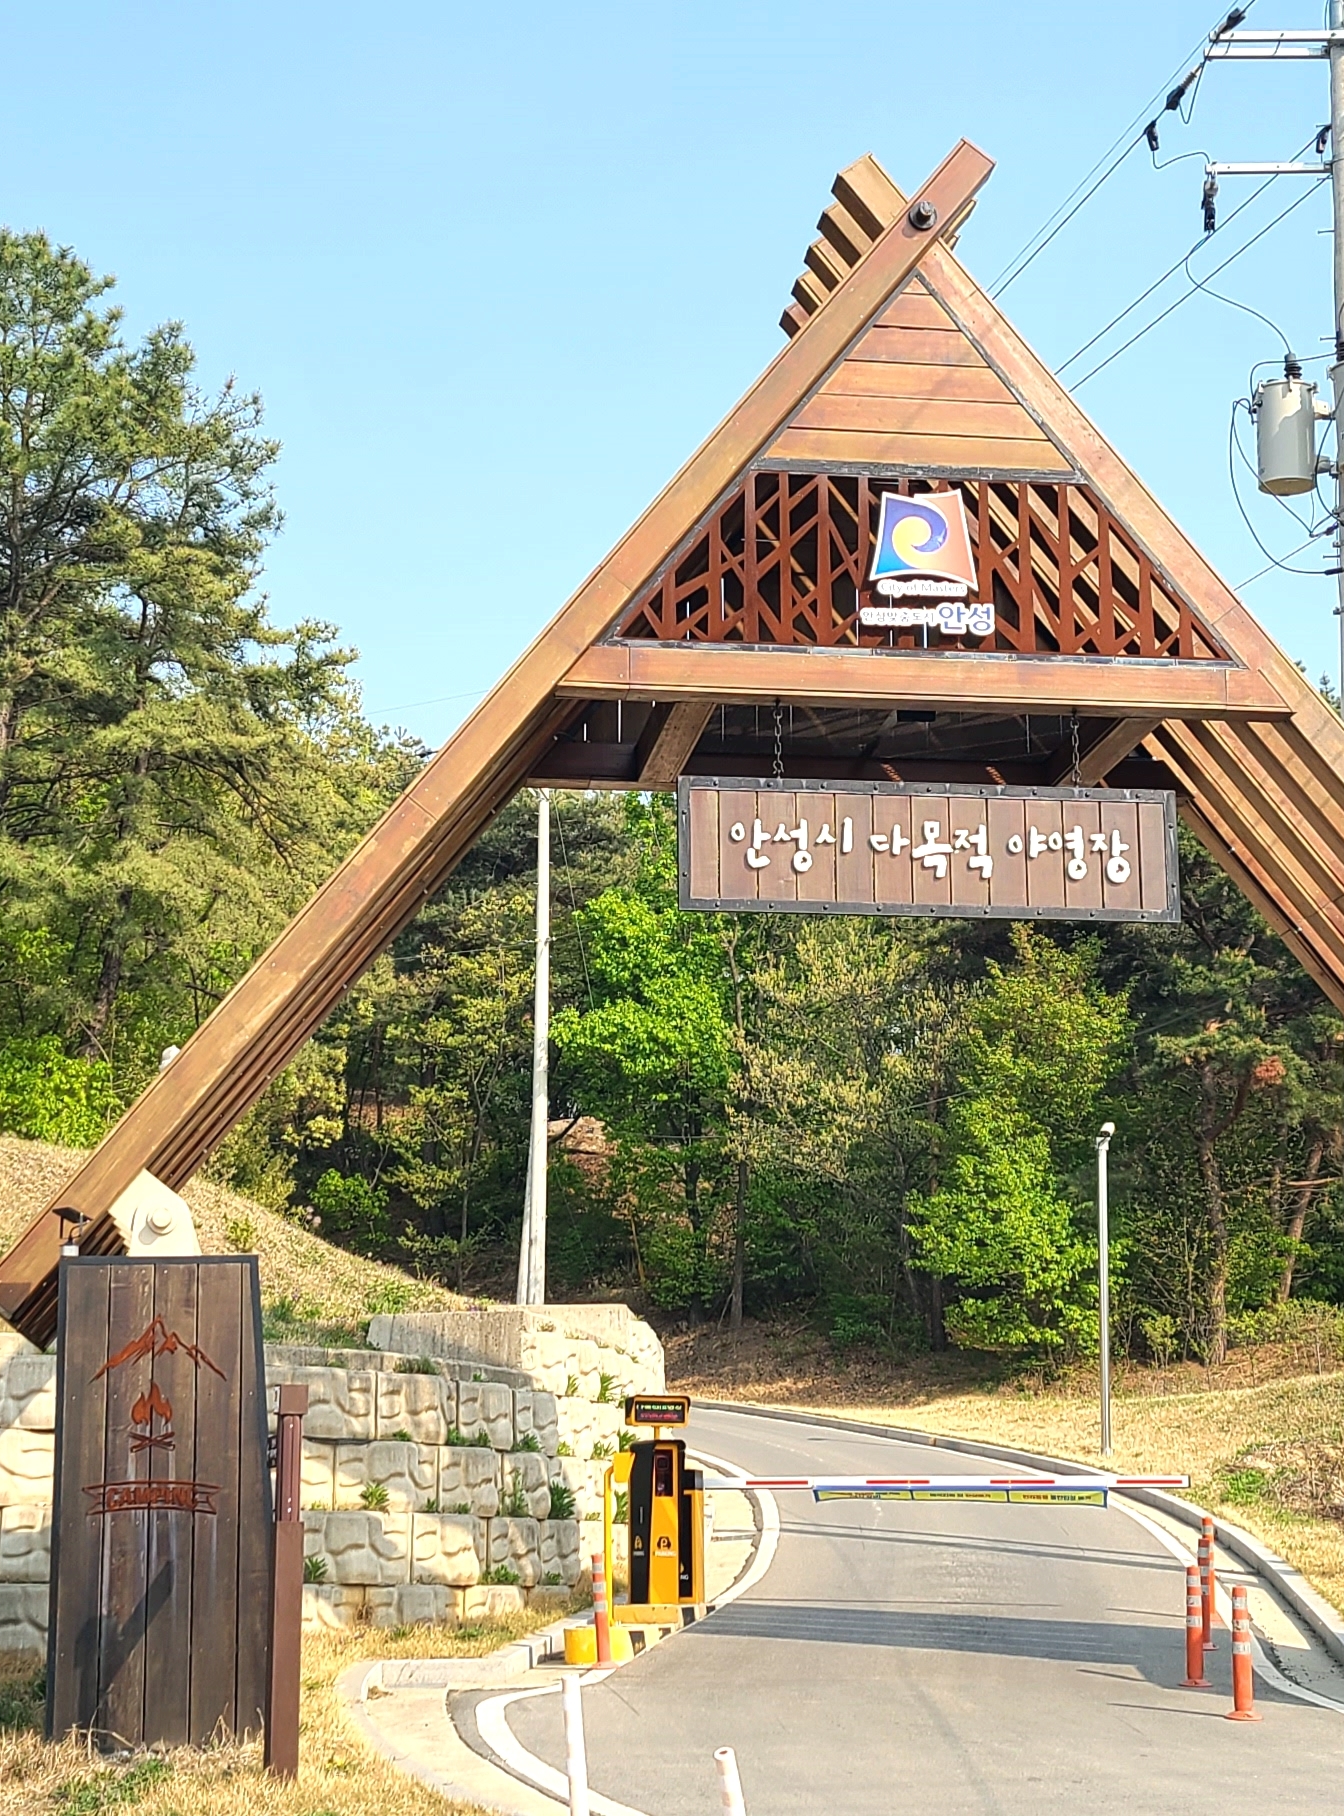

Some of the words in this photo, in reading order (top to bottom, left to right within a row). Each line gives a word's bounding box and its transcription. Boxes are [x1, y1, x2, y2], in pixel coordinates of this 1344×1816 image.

[880, 582, 902, 593] City
[906, 583, 917, 591] of
[921, 583, 965, 593] Masters
[938, 606, 992, 632] 안성
[730, 816, 854, 873] 안성시
[870, 820, 994, 879] 다목적
[1008, 824, 1131, 884] 야영장
[105, 1486, 198, 1510] CAMPING
